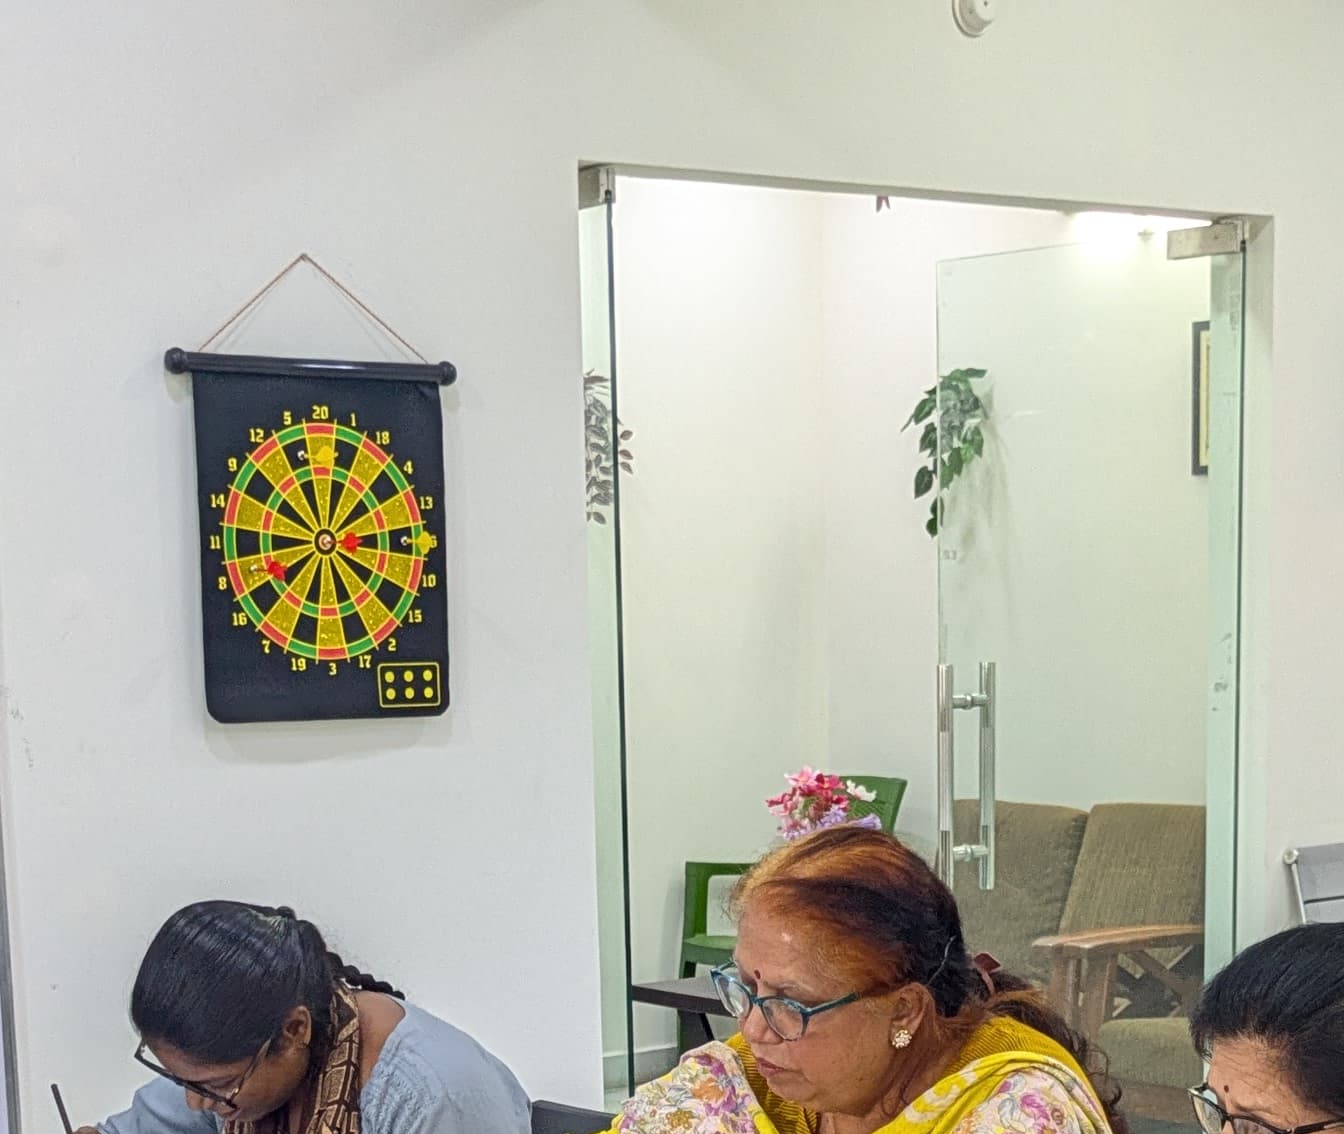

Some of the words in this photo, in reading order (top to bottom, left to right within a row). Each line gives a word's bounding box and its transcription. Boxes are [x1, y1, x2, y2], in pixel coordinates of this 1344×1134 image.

[283, 411, 292, 425] 5
[312, 406, 329, 420] 20
[350, 413, 356, 426] 1
[249, 429, 264, 443] 12
[375, 431, 390, 445] 18
[228, 458, 237, 472] 9
[403, 461, 413, 474] 4
[210, 494, 225, 508] 14
[419, 496, 433, 509] 13
[209, 537, 221, 549] 11
[218, 576, 226, 590] 8
[422, 574, 436, 587] 10
[232, 612, 247, 626] 16
[408, 609, 422, 623] 15
[262, 640, 270, 653] 7
[388, 638, 396, 651] 2
[291, 658, 306, 672] 19
[358, 655, 371, 668] 17
[329, 662, 337, 676] 3
